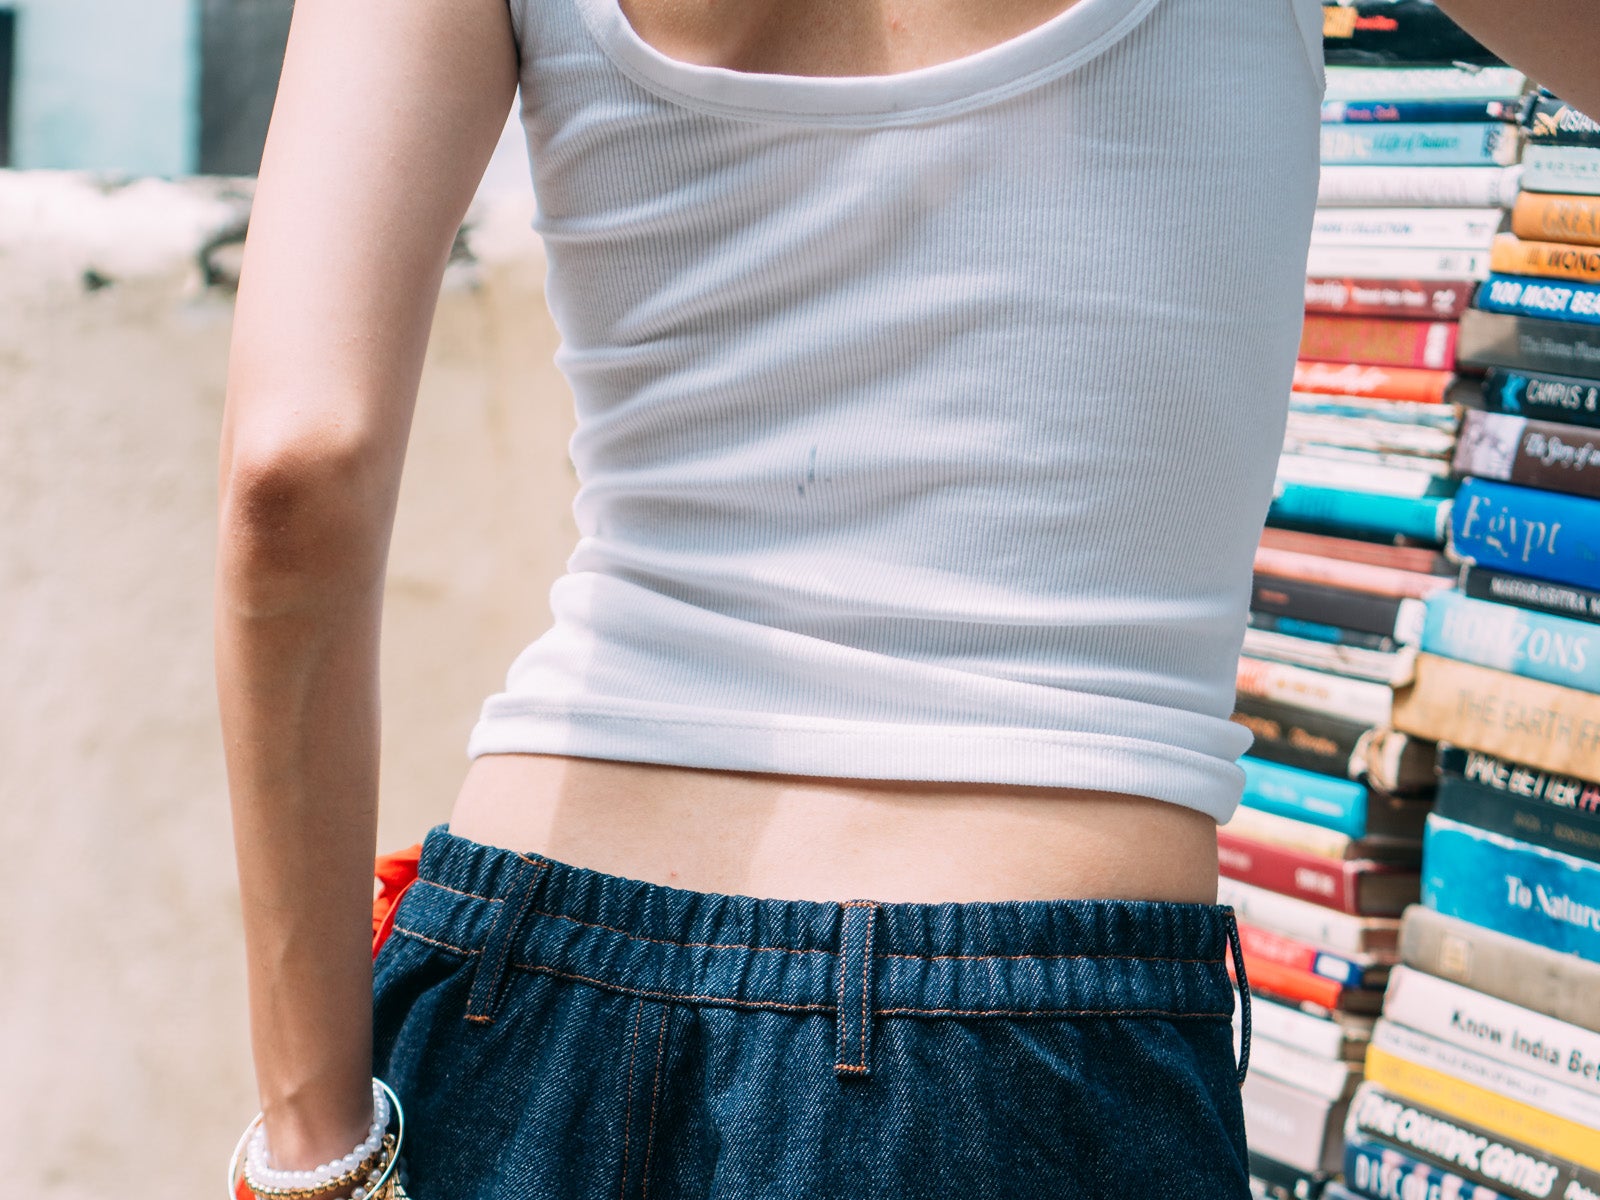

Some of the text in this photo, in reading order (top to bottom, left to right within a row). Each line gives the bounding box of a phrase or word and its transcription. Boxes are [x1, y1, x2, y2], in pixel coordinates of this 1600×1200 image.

[1520, 285, 1573, 312] MOST
[1526, 379, 1598, 412] CAMPUS &
[1442, 607, 1590, 674] HOZONS
[1503, 700, 1572, 740] EARTH
[1505, 874, 1533, 910] To
[1450, 1009, 1502, 1044] Know
[1511, 1029, 1560, 1066] India
[1396, 1108, 1488, 1171] OLYMPIC
[1480, 1143, 1559, 1198] GAMES
